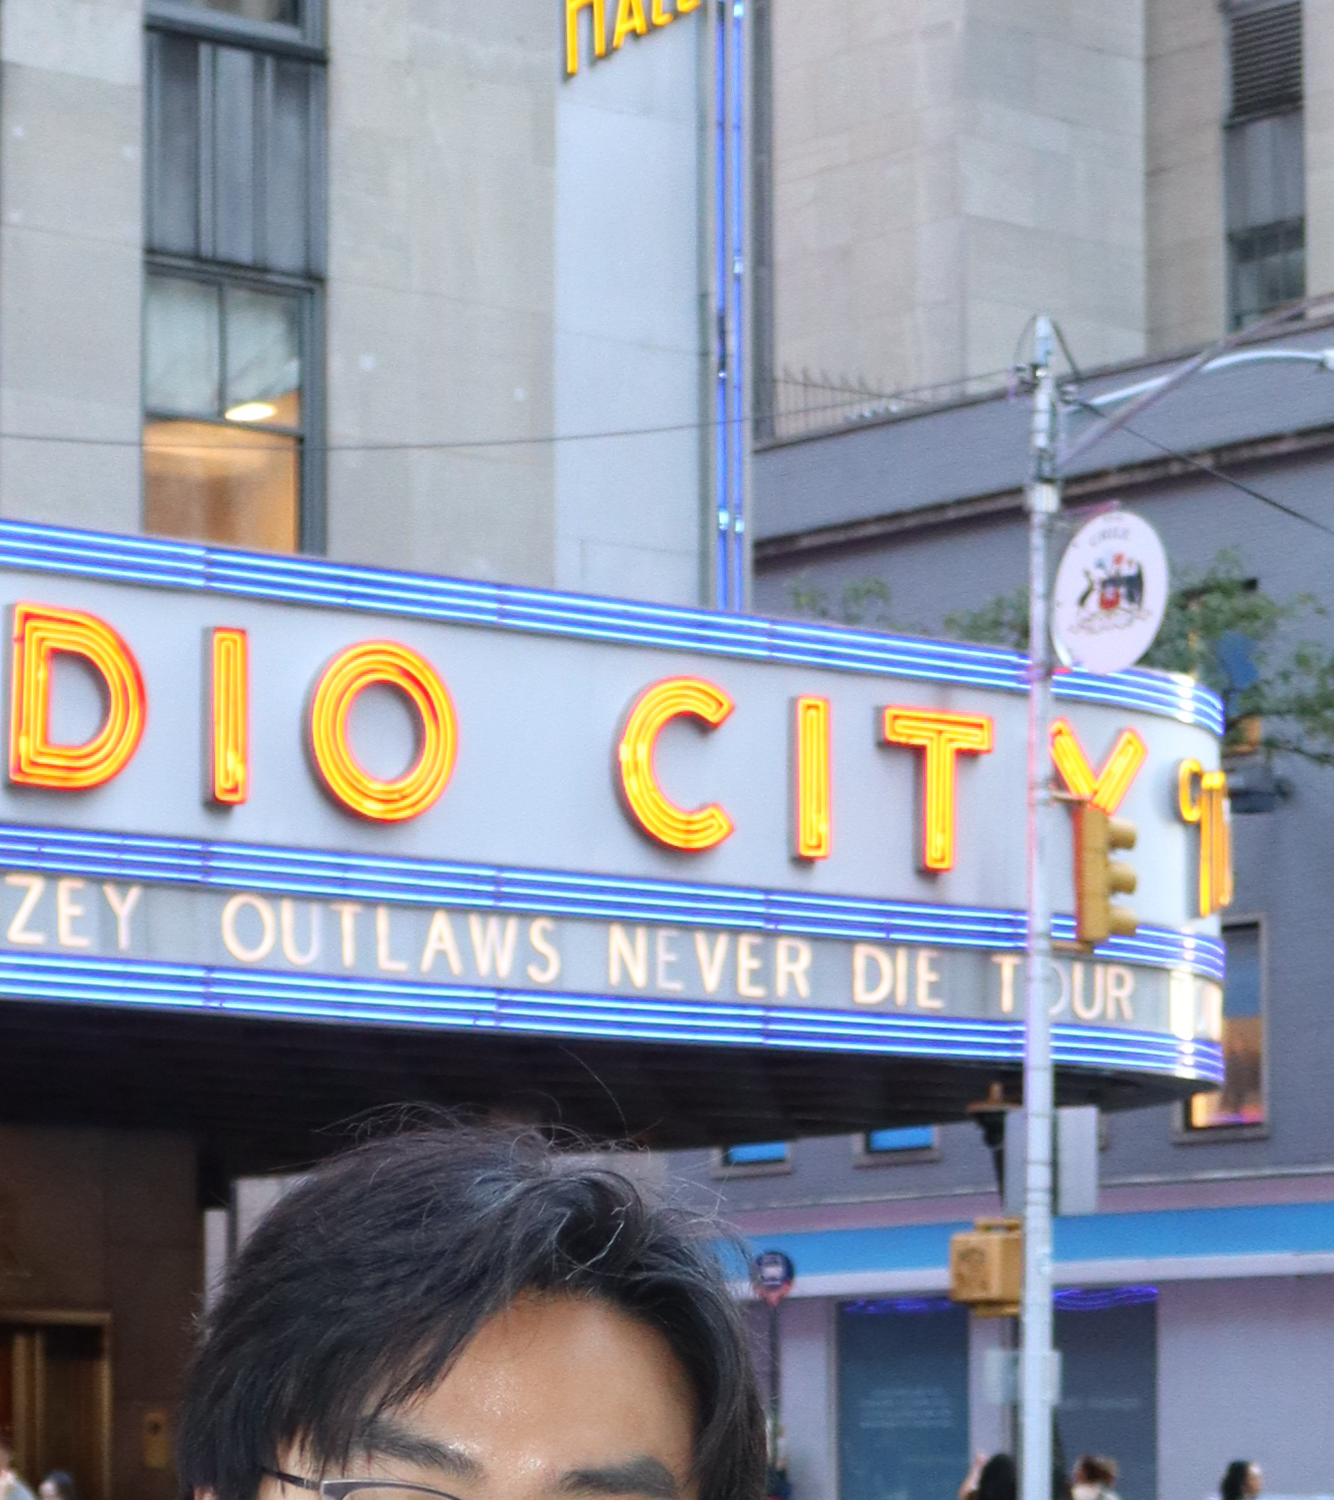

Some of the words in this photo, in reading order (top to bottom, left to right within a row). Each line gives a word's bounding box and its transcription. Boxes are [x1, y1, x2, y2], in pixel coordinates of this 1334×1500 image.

[619, 674, 1148, 873] CITY
[220, 894, 562, 986] OUTLAWS
[608, 924, 812, 1000] NEVER
[852, 945, 945, 1010] DIE
